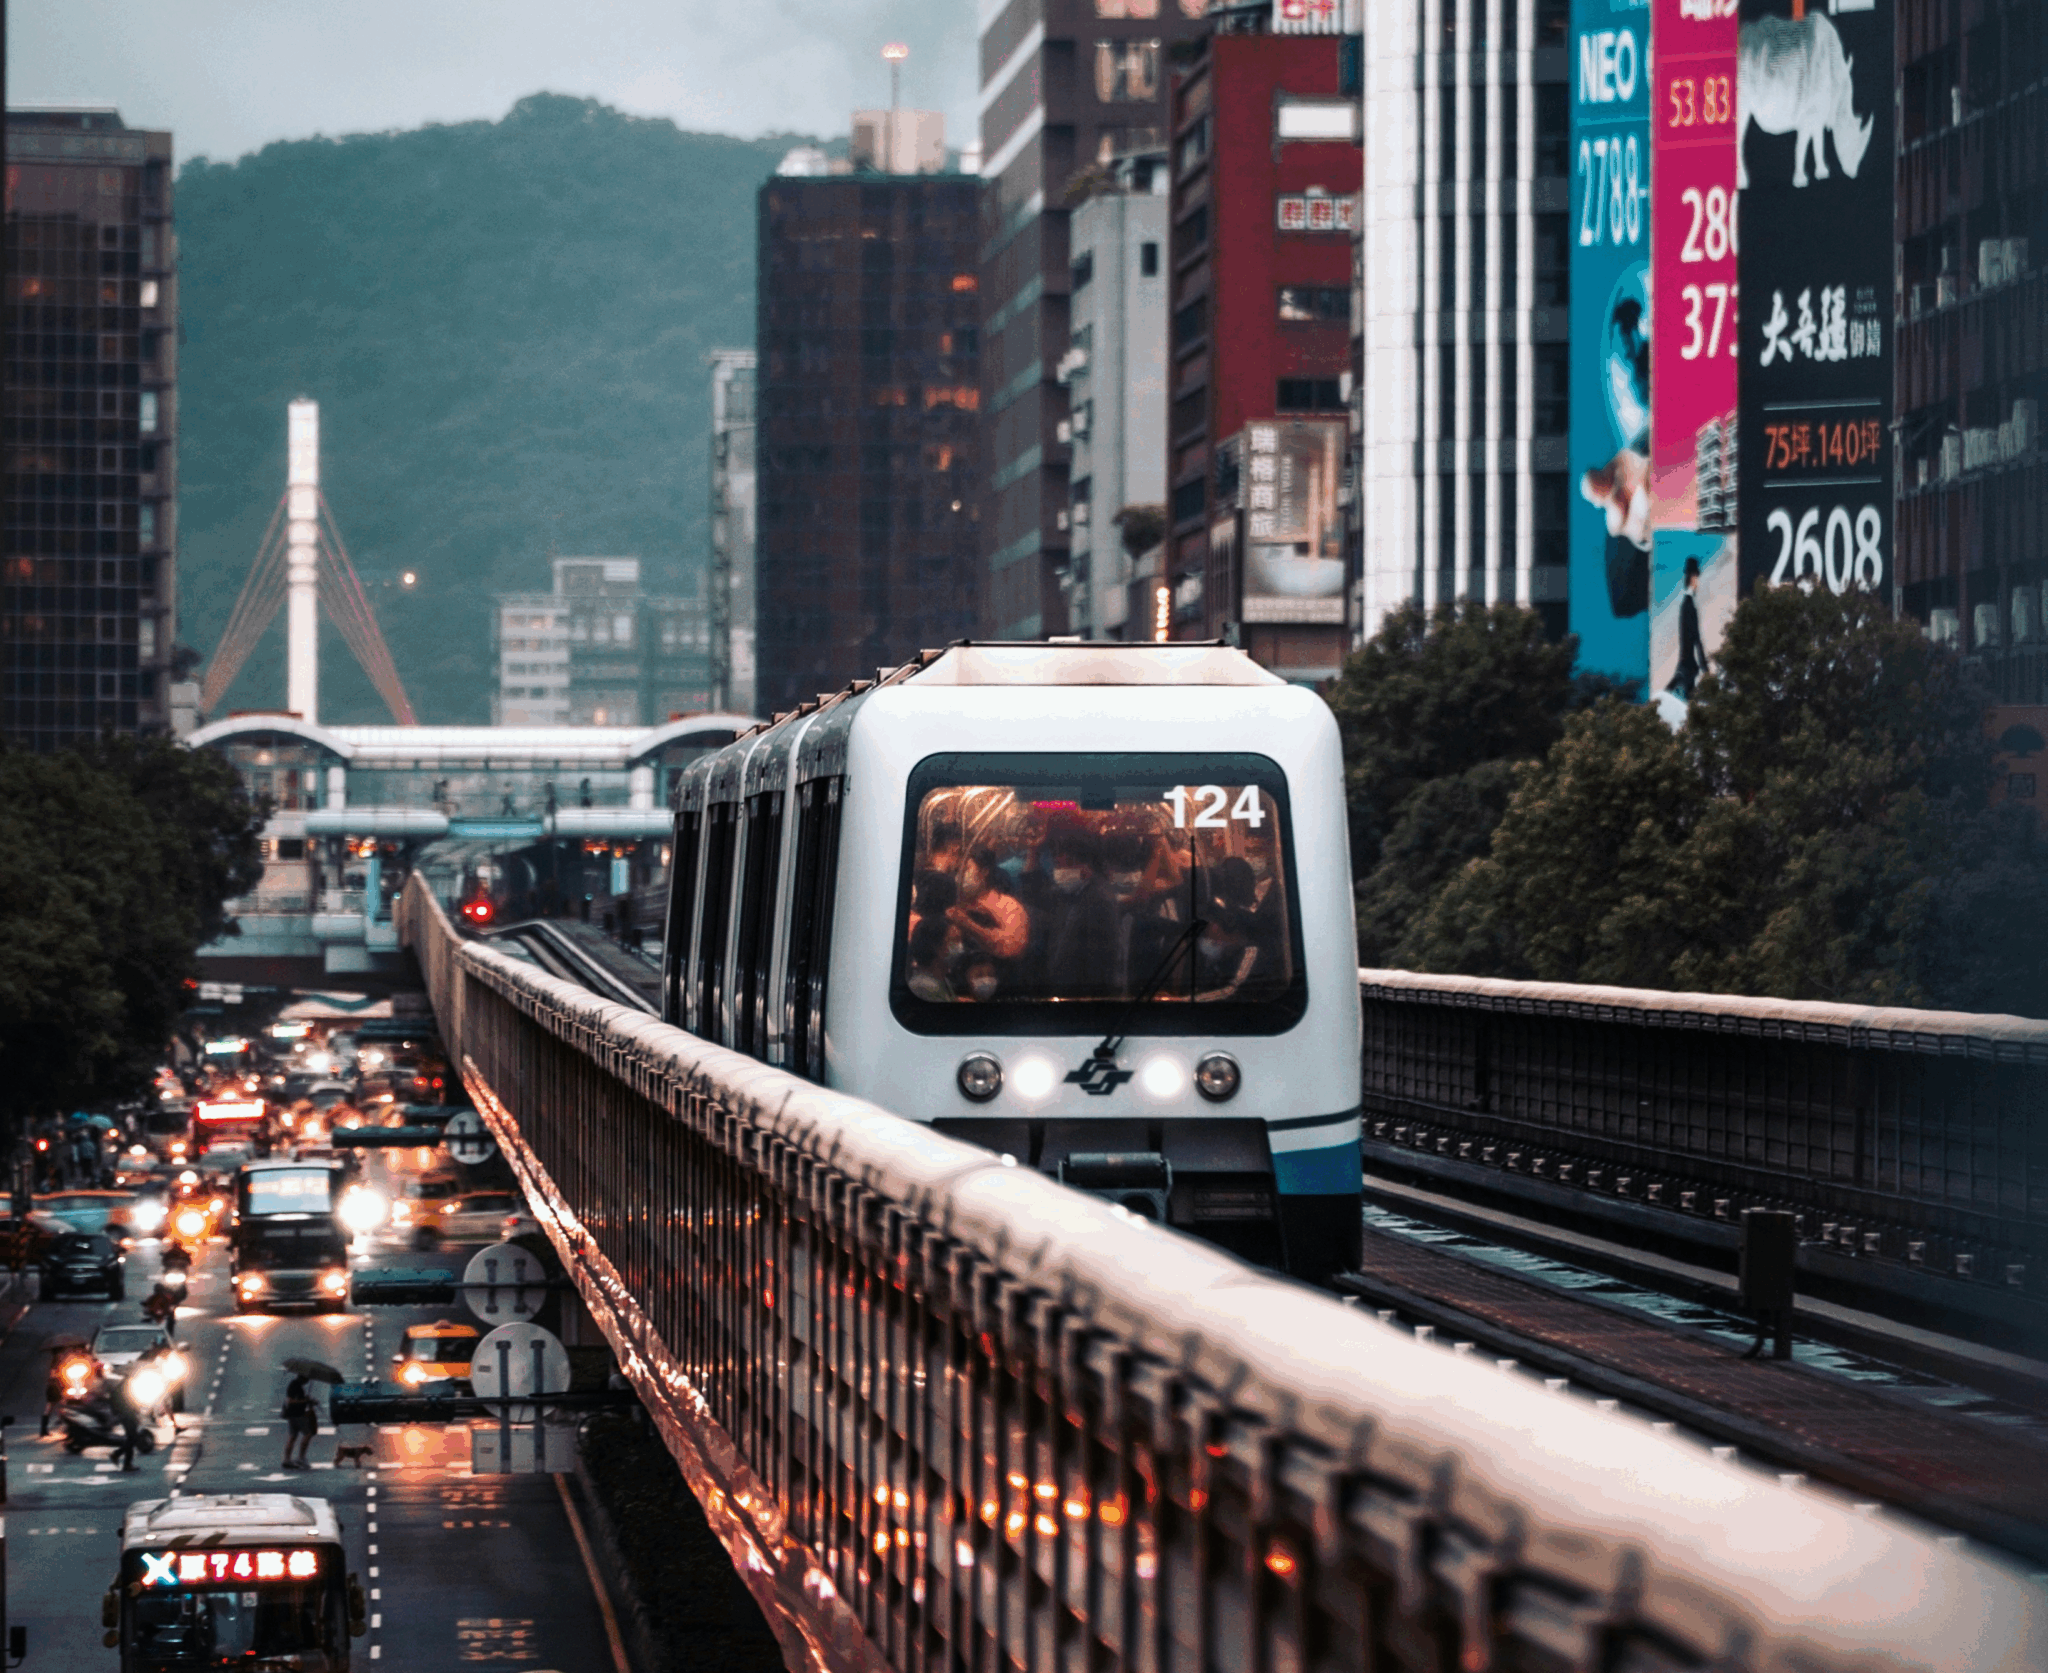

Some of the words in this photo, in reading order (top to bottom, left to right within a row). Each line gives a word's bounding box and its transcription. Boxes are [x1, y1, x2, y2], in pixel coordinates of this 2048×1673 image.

[1579, 28, 1637, 104] NEO
[1767, 504, 1883, 598] 2608
[1163, 785, 1266, 828] 124
